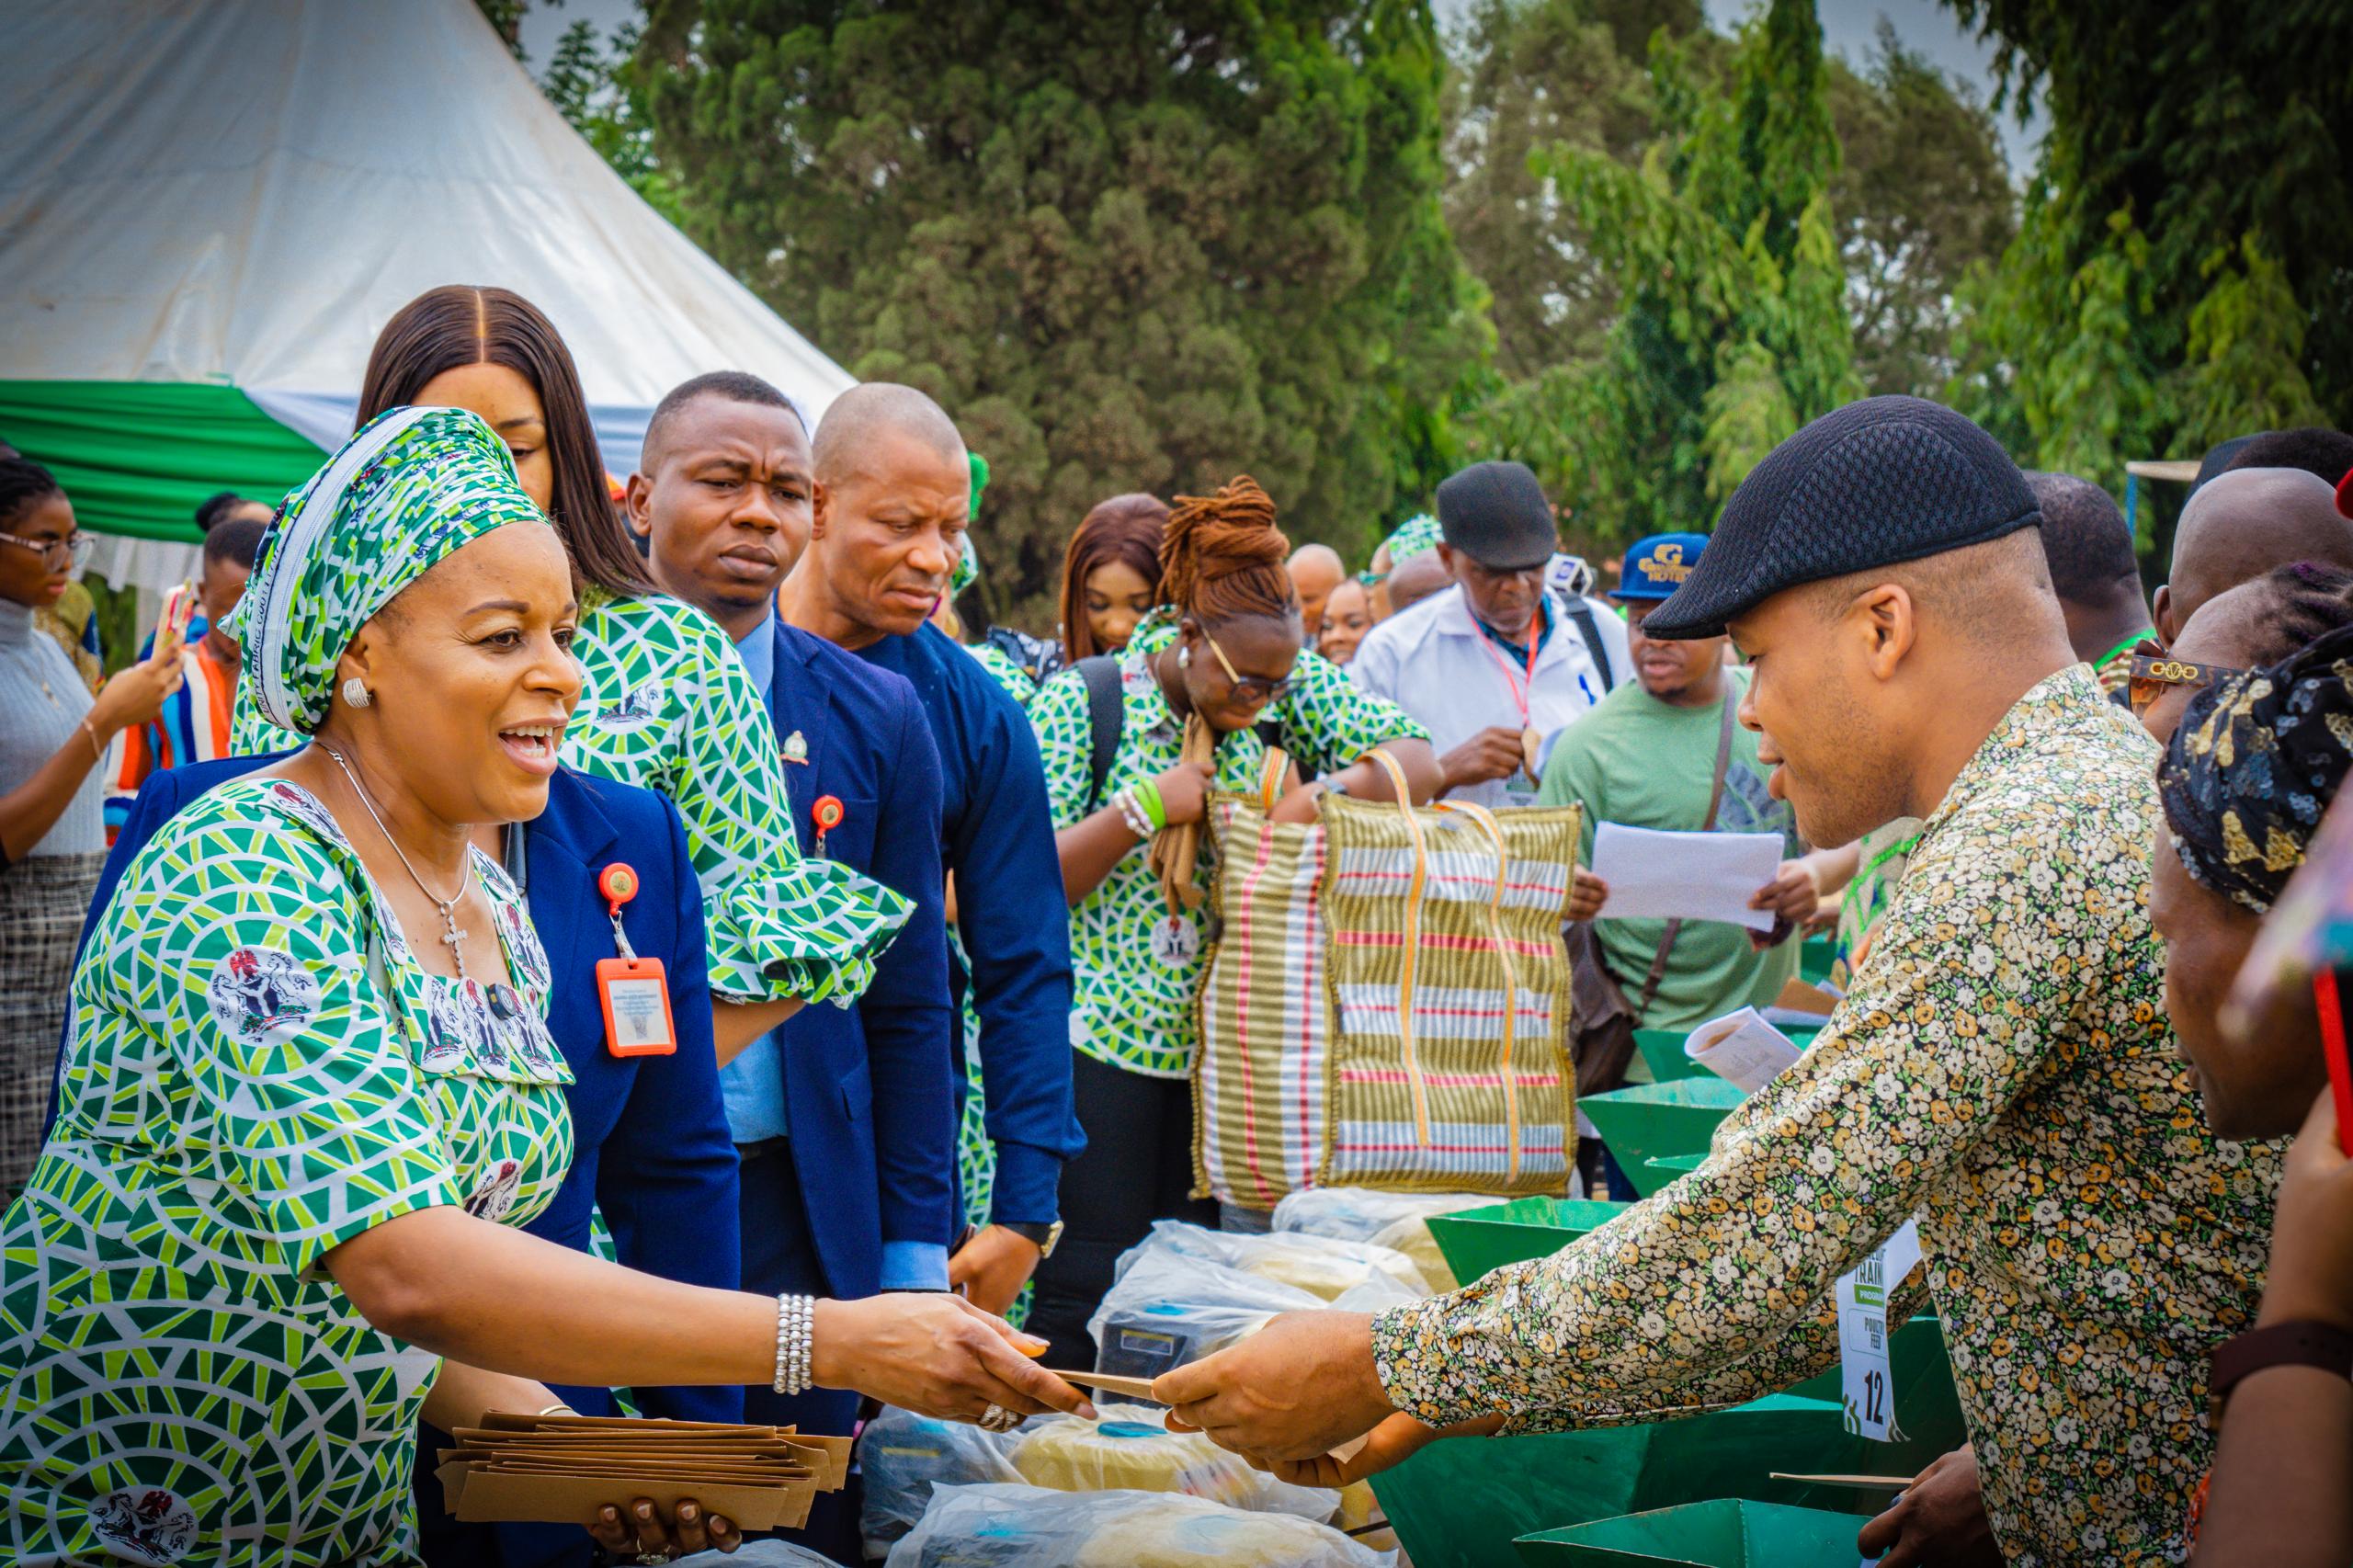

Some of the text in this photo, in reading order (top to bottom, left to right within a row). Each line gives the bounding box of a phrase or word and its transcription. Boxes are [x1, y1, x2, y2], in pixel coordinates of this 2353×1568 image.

[253, 629, 270, 713] UNITY FABRIC
[1870, 1333, 1881, 1350] FEED
[1864, 1369, 1883, 1425] 12
